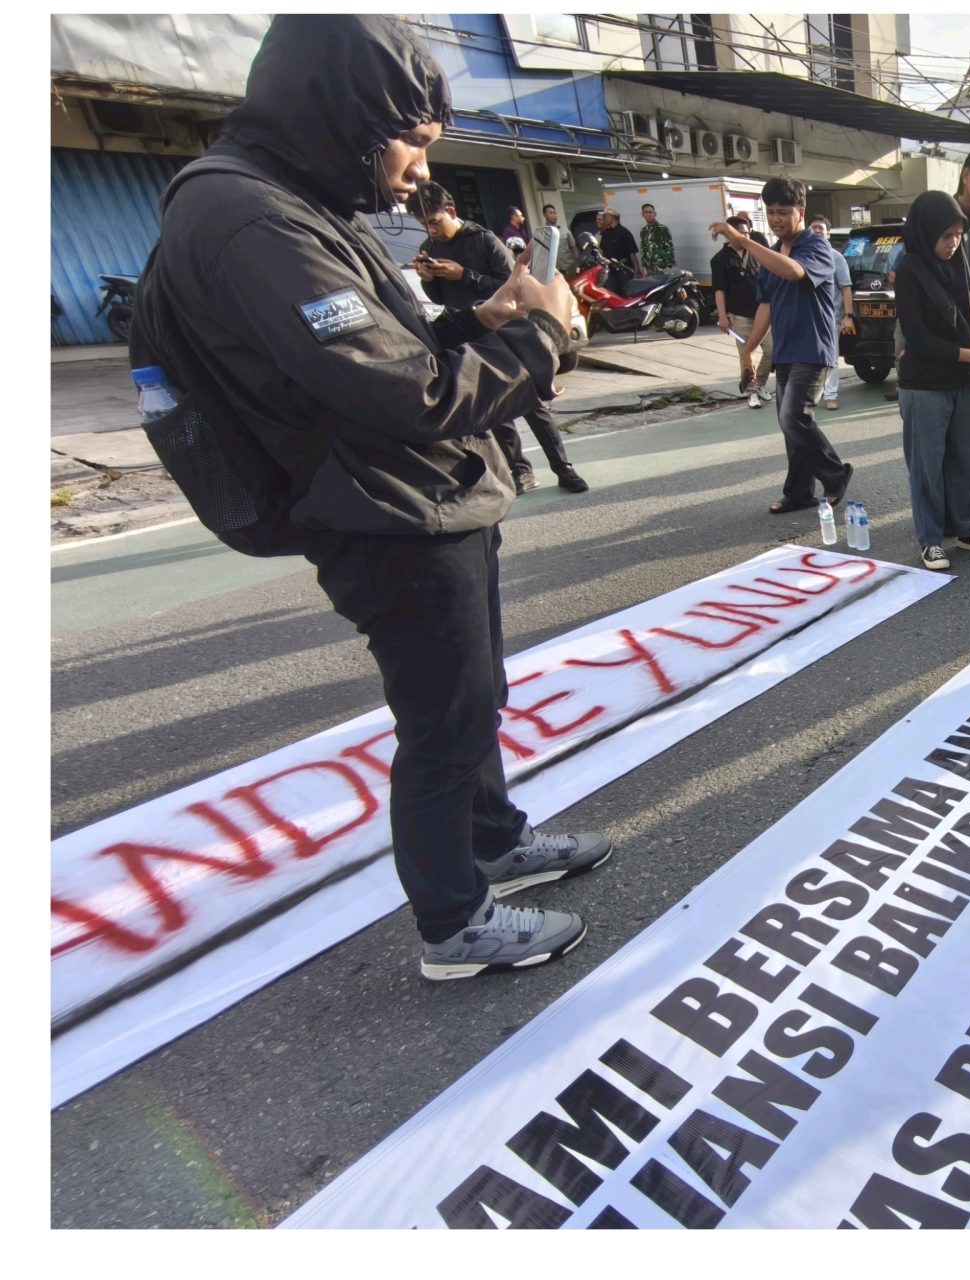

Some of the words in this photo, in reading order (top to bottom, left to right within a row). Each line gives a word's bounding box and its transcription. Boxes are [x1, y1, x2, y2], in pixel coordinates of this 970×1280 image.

[51, 672, 604, 952] ANDE
[563, 553, 877, 695] YUNUS
[436, 1037, 694, 1229] AMI
[649, 776, 969, 1058] BERSAMA
[587, 982, 880, 1229] IANSI
